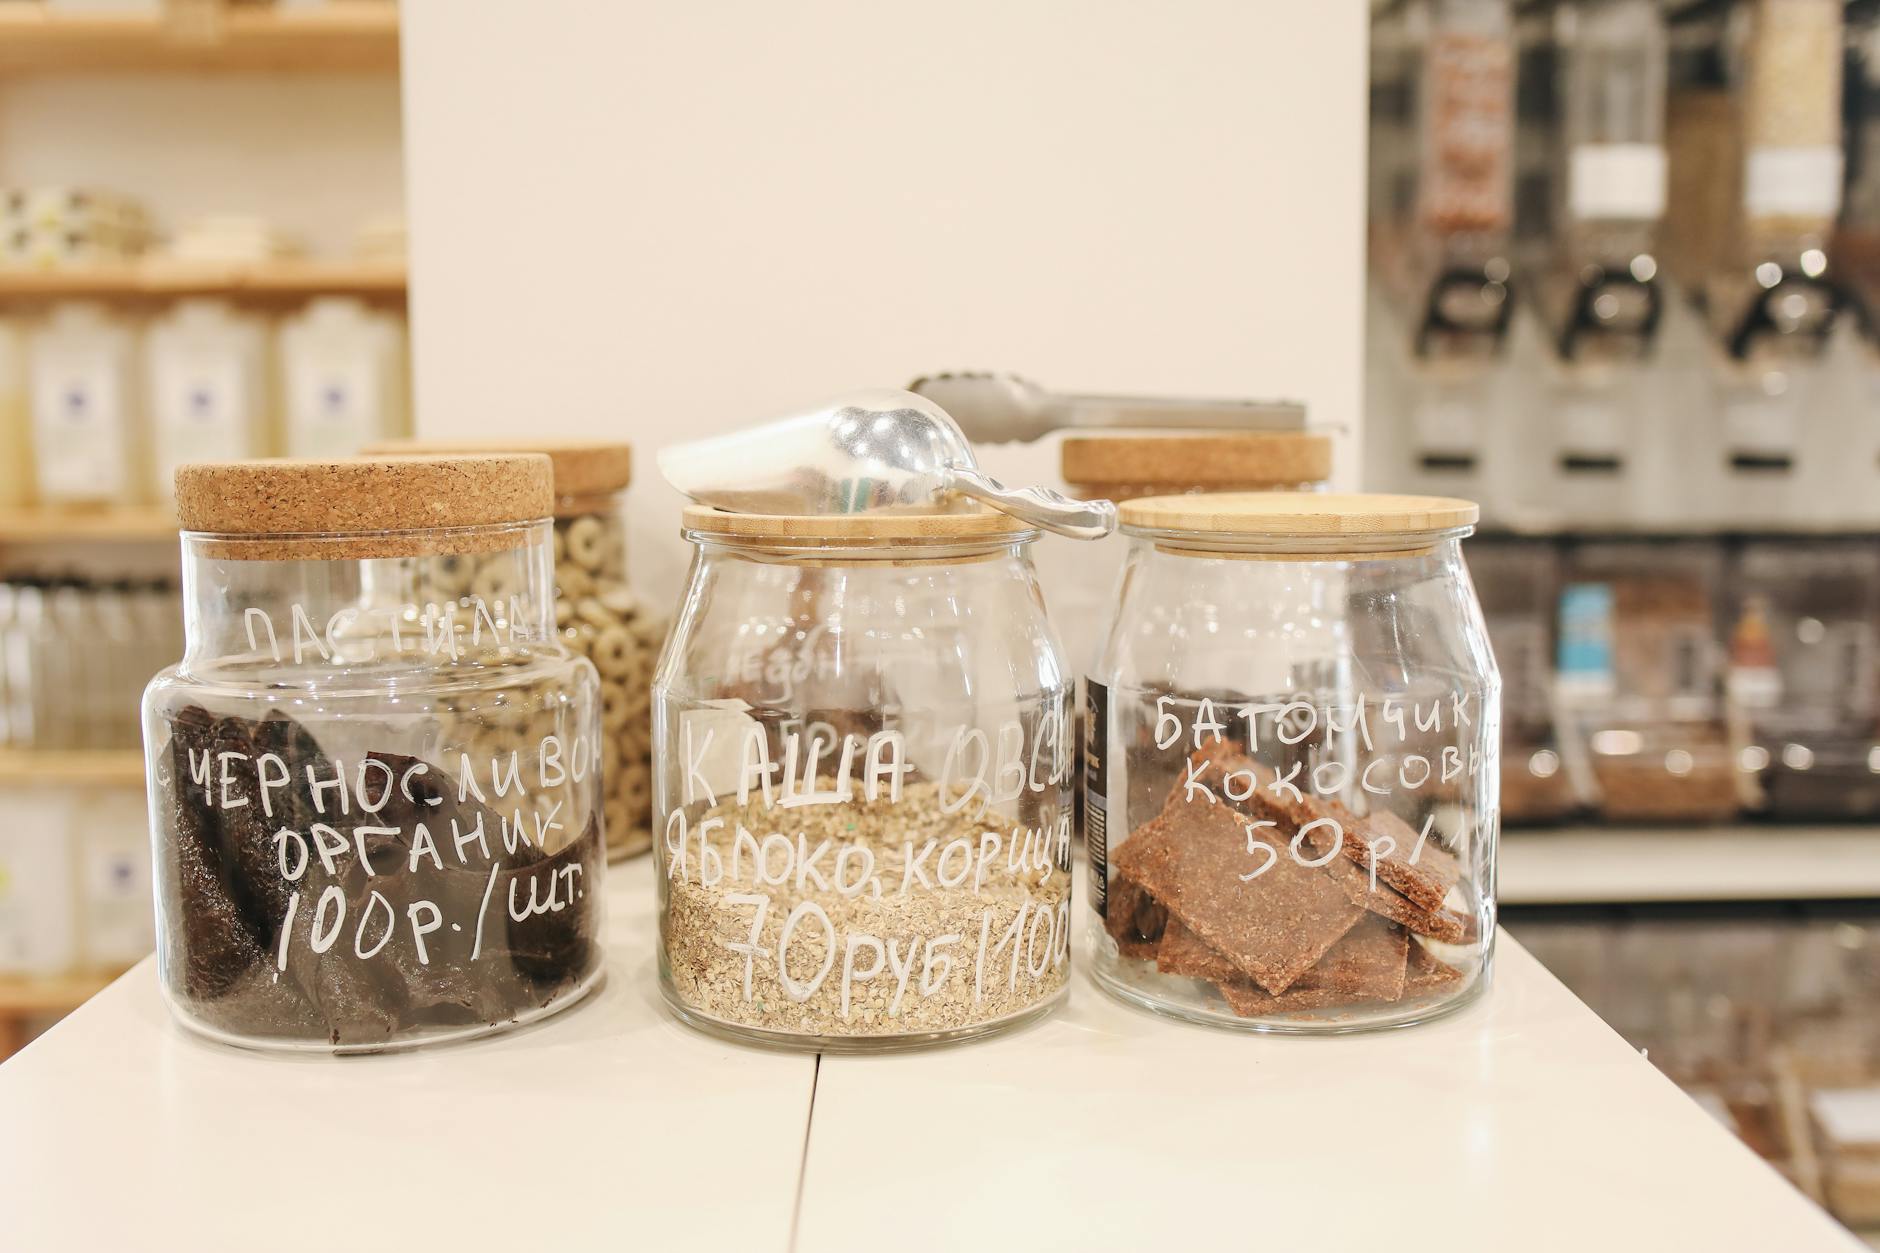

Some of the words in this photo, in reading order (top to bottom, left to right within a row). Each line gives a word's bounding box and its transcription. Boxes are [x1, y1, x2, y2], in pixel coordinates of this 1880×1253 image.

[244, 595, 530, 664] ПАСТИЛА
[686, 720, 915, 809] КАША
[272, 800, 563, 881] ОРГАНИК
[666, 808, 881, 899] ЯБЛОКО,
[900, 815, 1071, 894] КОРИЦА
